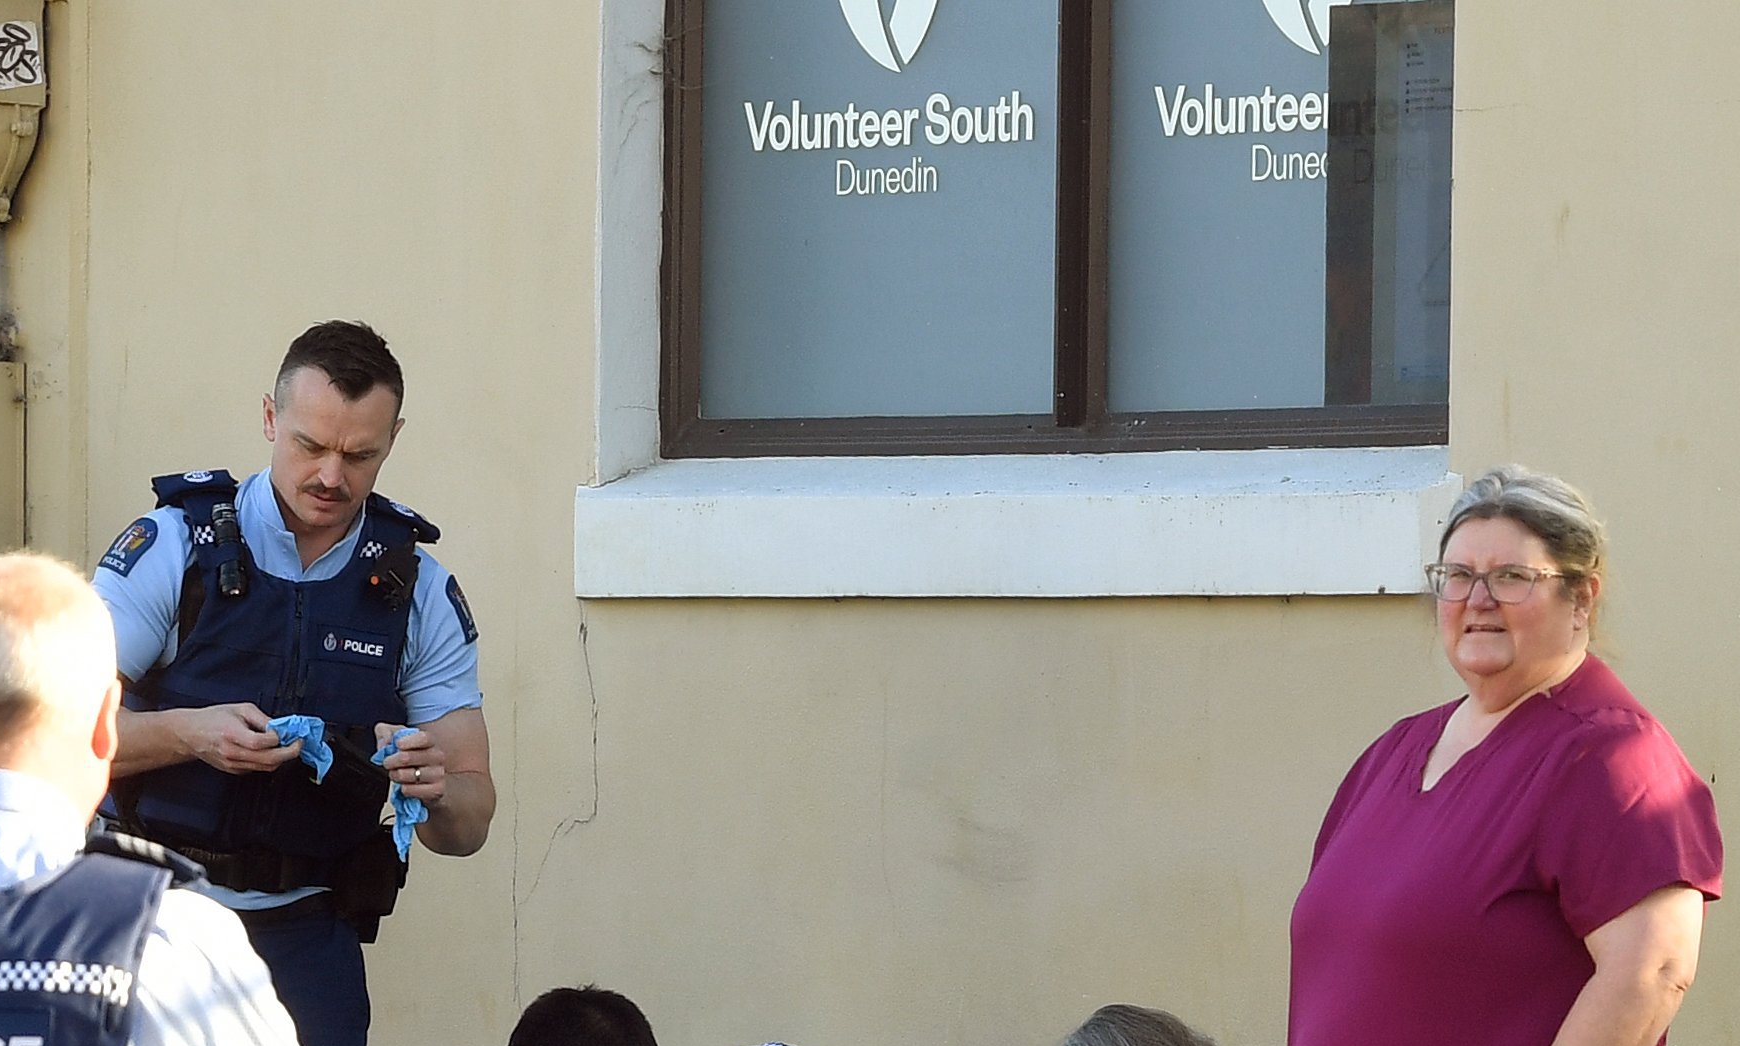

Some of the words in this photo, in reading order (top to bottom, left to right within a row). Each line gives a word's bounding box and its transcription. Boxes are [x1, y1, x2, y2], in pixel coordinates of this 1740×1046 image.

[745, 99, 919, 151] Volunteer
[925, 91, 1034, 145] South
[836, 156, 938, 196] Dunedin
[1251, 144, 1327, 181] Dune
[343, 639, 384, 657] POLICE
